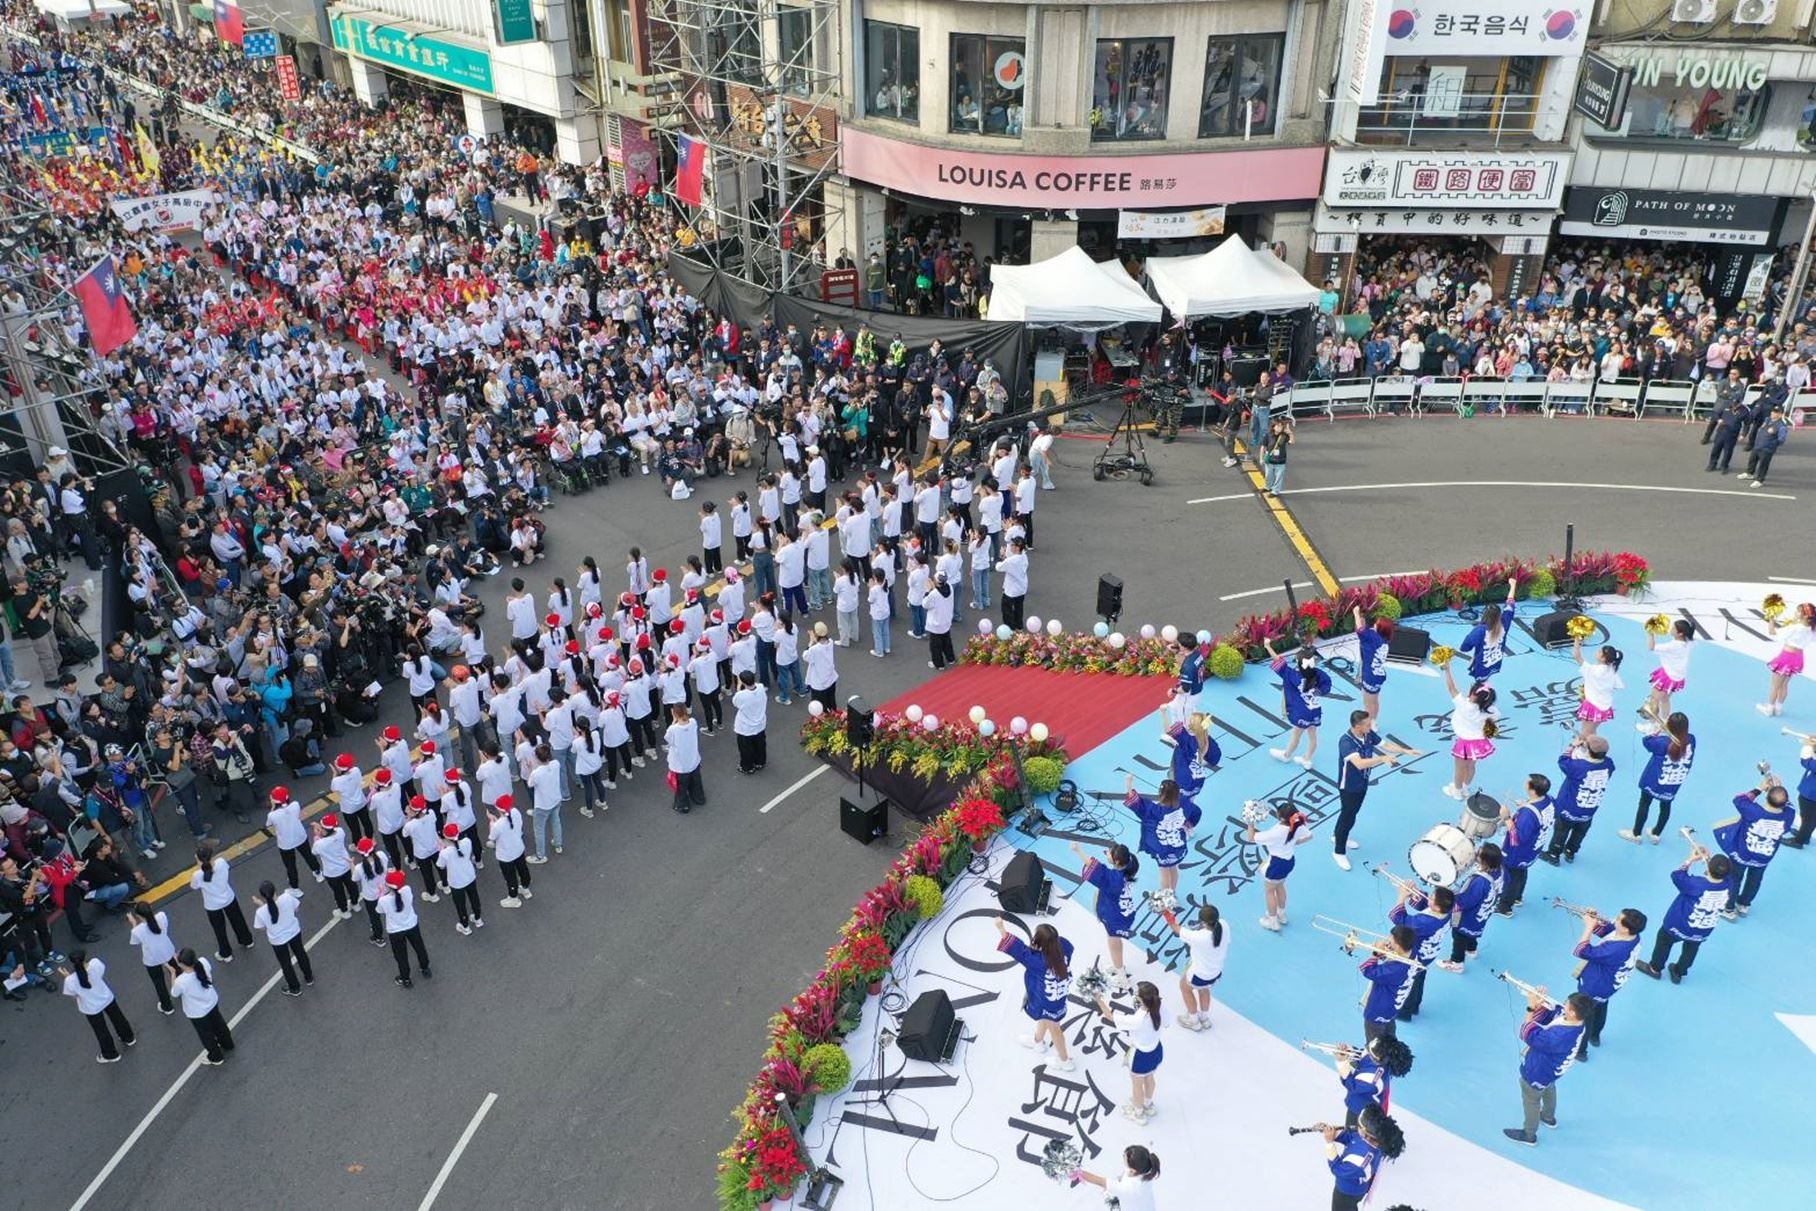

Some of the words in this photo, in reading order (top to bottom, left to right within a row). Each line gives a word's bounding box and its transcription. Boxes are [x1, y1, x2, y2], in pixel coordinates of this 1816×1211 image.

[1434, 14, 1529, 37] 한국음식
[1675, 58, 1768, 91] YOUNG
[938, 164, 1027, 191] LOUISA
[1035, 171, 1132, 192] COFFEE
[1140, 177, 1177, 192] 路易莎
[1416, 171, 1533, 190] 鐵路便當
[1635, 200, 1668, 210] PATH
[1674, 202, 1691, 211] OF
